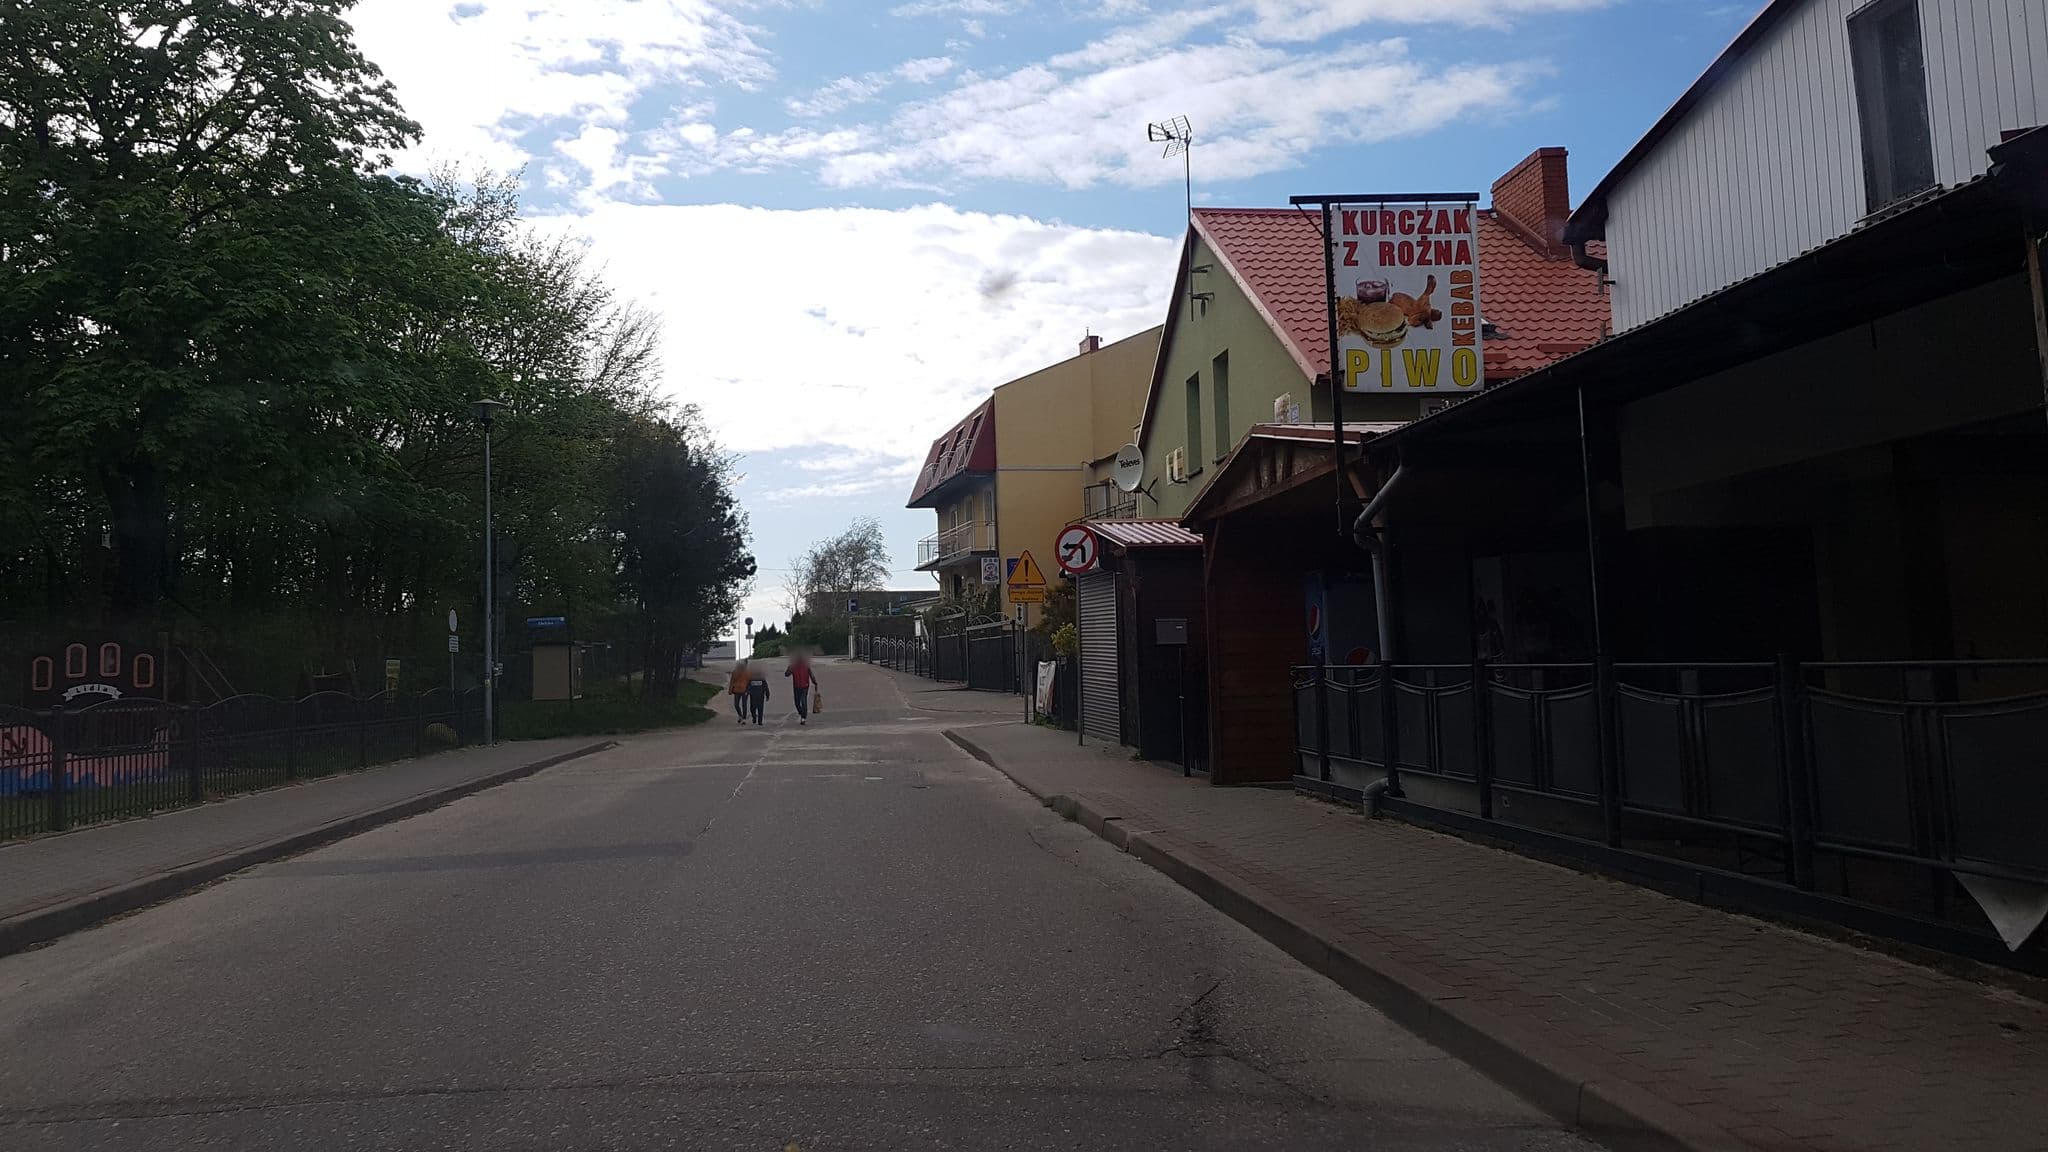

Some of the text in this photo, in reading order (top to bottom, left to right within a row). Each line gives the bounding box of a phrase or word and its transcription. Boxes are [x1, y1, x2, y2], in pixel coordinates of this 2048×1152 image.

[1343, 210, 1471, 235] KURCZAK
[1343, 236, 1472, 266] Z ROŻNA
[1451, 270, 1475, 346] KEBAB
[1346, 348, 1477, 387] PIWO
